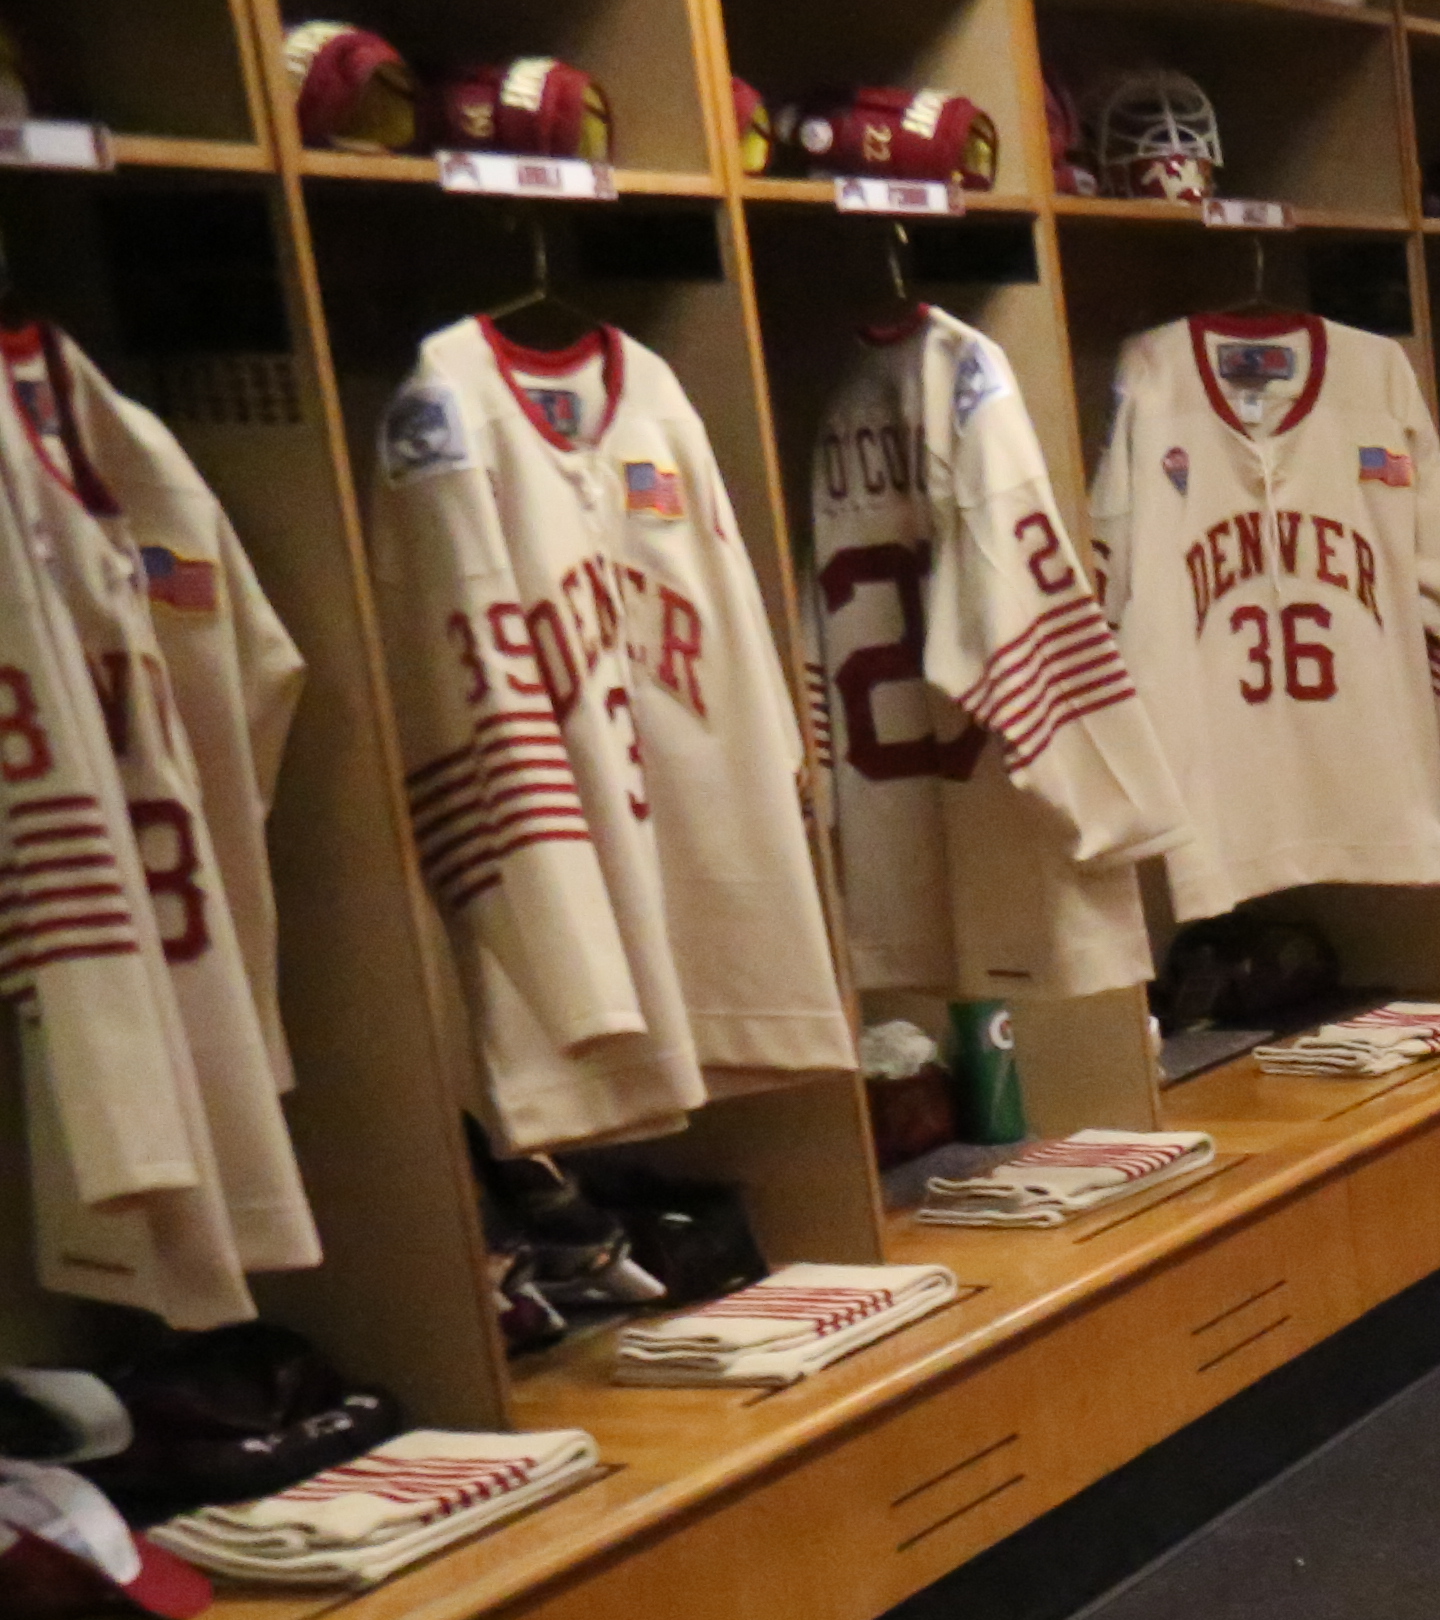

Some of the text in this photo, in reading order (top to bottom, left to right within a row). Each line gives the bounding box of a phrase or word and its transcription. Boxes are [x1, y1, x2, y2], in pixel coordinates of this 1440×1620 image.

[1014, 511, 1075, 595] 2
[1185, 509, 1383, 641] DENVER
[1230, 602, 1338, 705] 36
